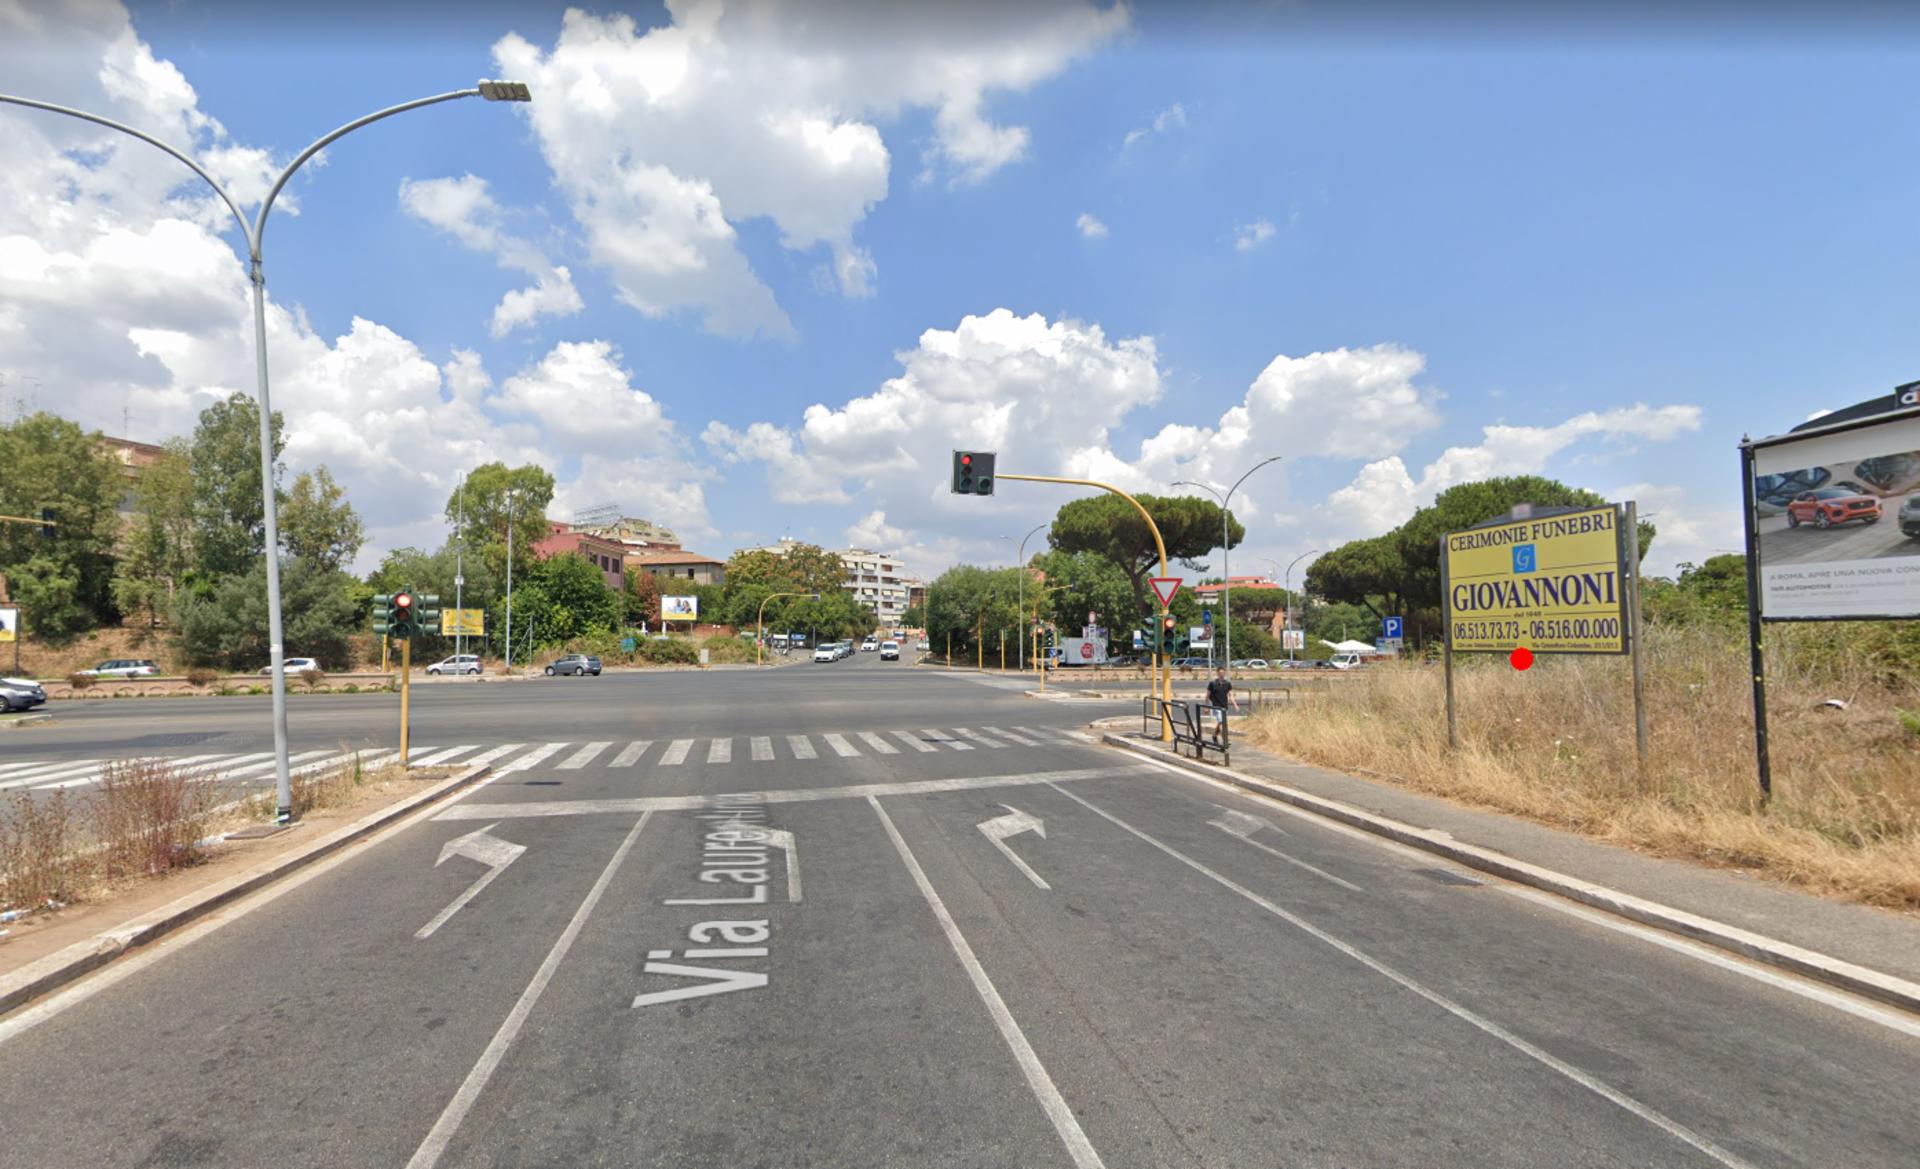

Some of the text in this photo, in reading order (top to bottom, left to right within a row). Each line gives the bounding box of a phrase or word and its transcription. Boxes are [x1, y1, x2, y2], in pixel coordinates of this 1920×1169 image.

[1450, 512, 1613, 552] CERIMONIE FUNEBRI
[1453, 571, 1617, 611] GIOVANNONI
[1386, 619, 1398, 637] P
[1454, 621, 1519, 639] 06.513.73.73
[1530, 618, 1618, 639] 06.516.00.000
